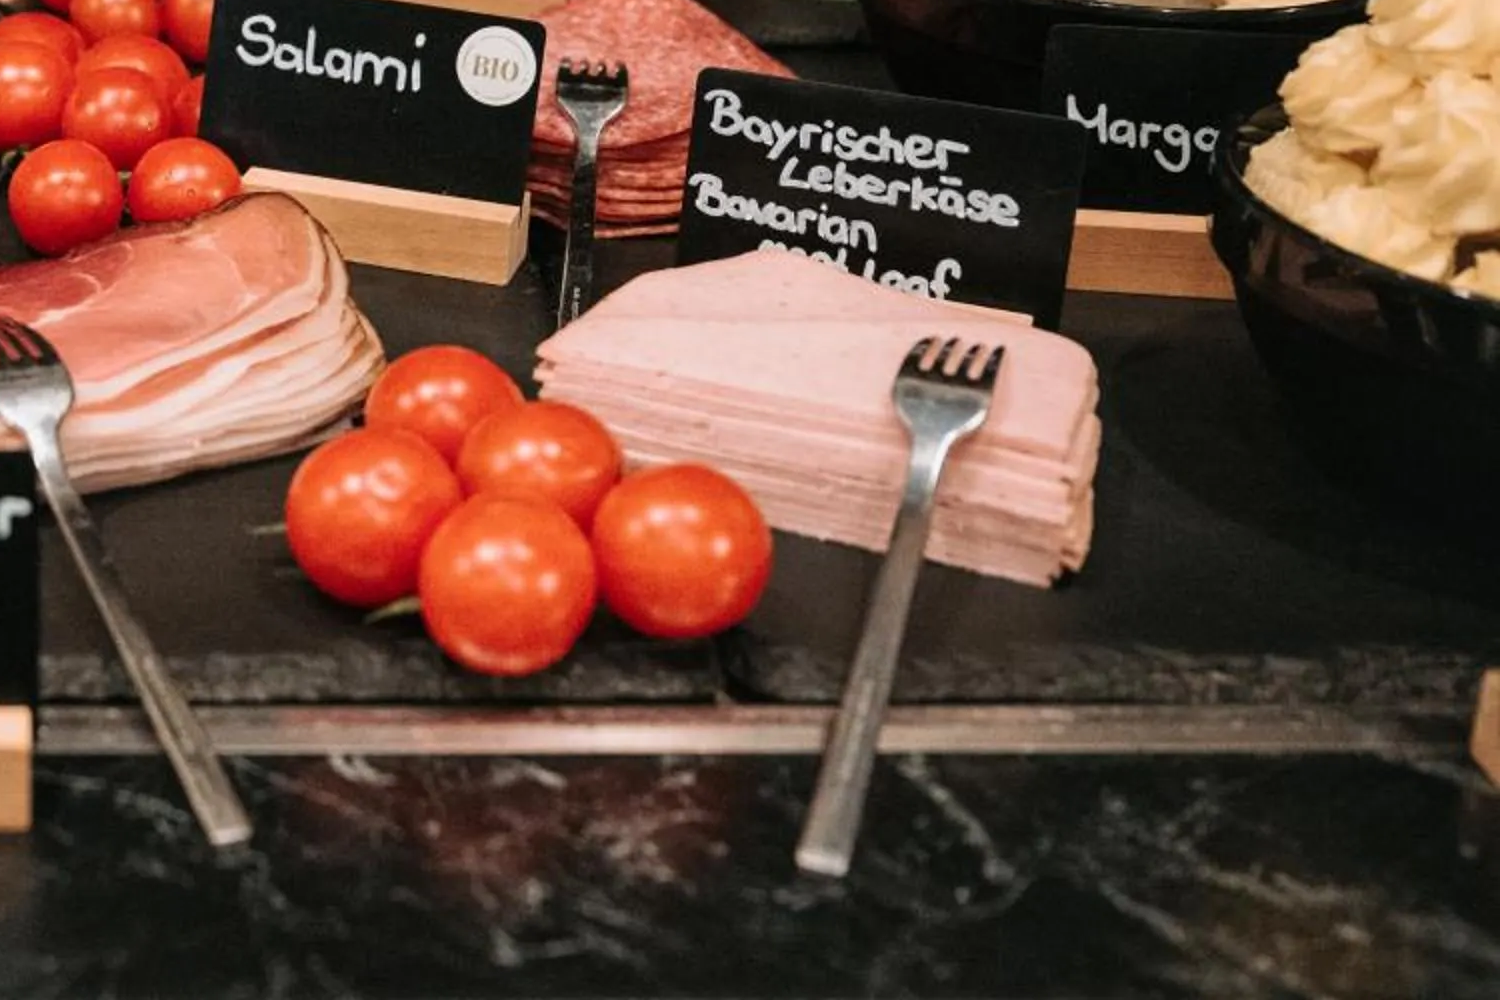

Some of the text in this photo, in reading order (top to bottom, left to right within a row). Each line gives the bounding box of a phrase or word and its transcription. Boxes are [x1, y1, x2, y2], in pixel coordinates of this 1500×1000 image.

[235, 14, 427, 92] Salami
[471, 54, 520, 83] BIO
[703, 89, 970, 170] Bayrischer
[688, 173, 878, 253] Bavarian
[779, 157, 1021, 227] Leberkäse
